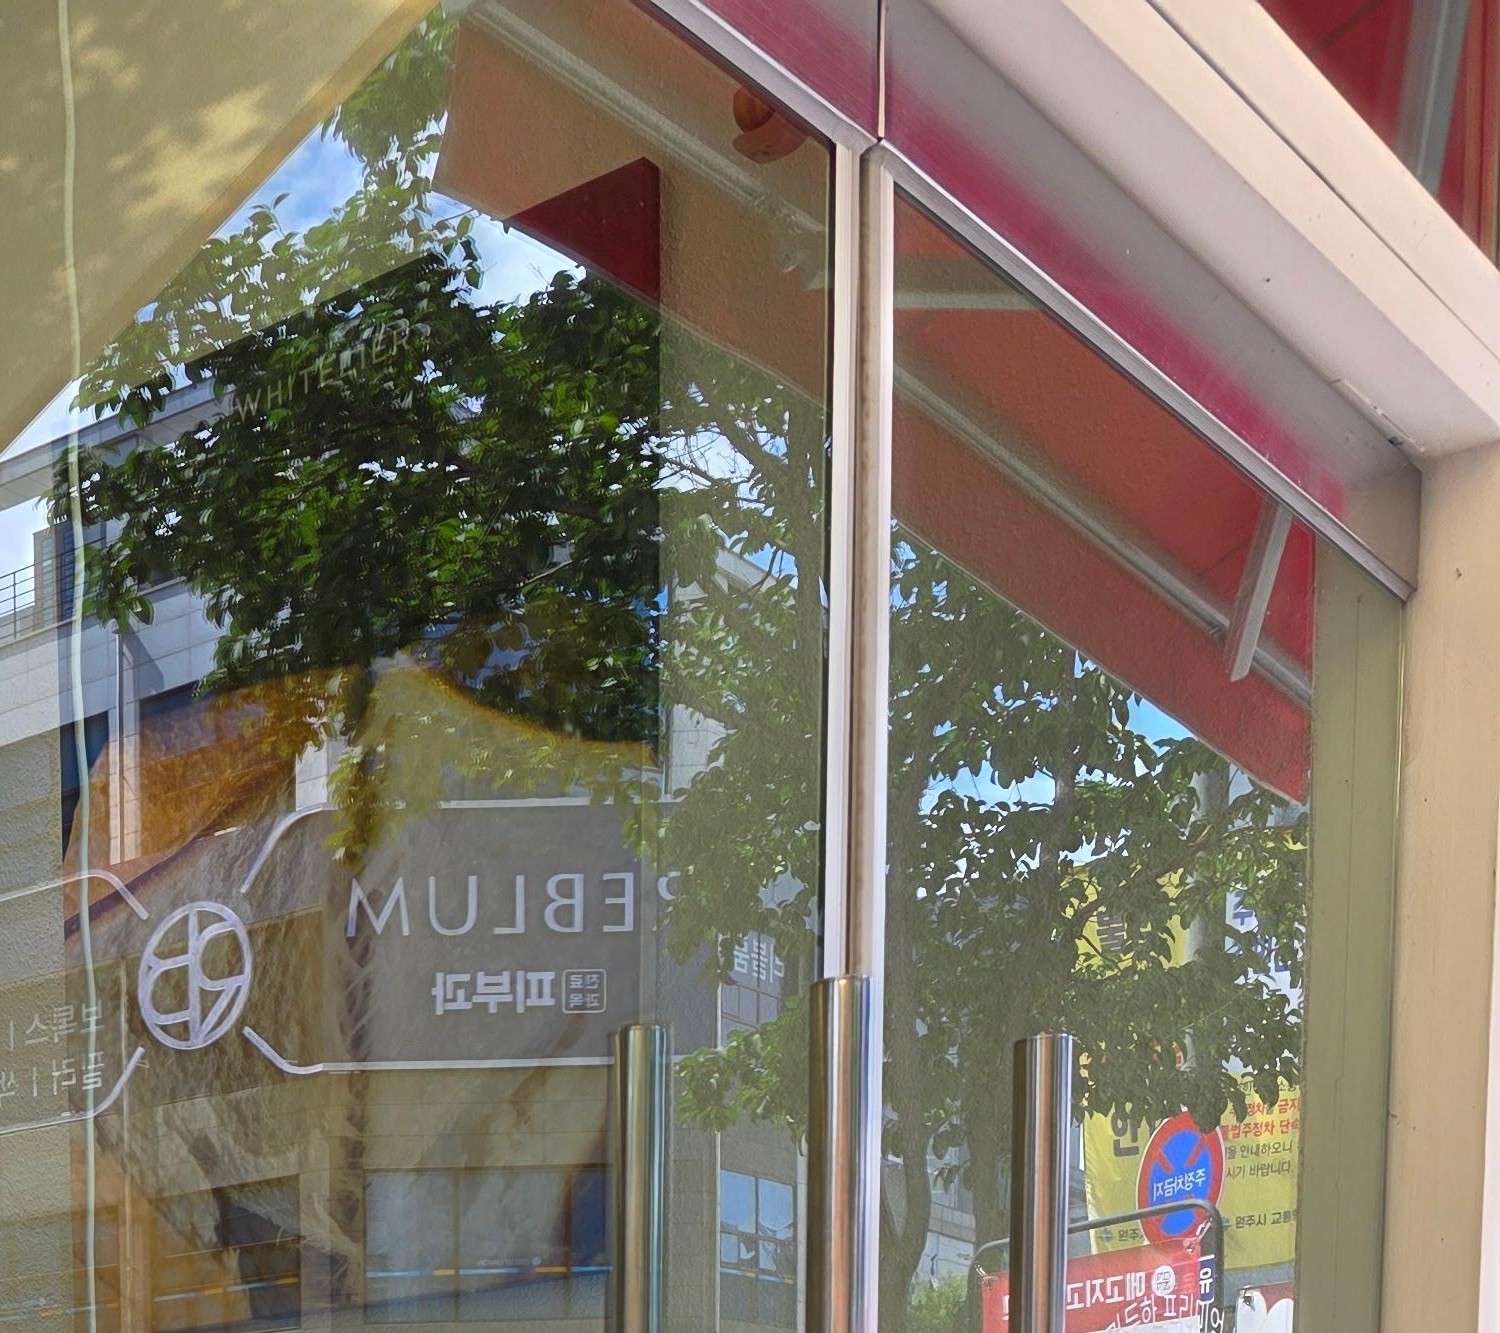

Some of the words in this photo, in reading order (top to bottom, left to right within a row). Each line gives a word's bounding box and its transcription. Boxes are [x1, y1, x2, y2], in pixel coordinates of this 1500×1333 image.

[1240, 1141, 1293, 1159] 안내하오니
[1250, 1161, 1294, 1178] 바랍니다.
[1234, 1213, 1267, 1229] 원주시
